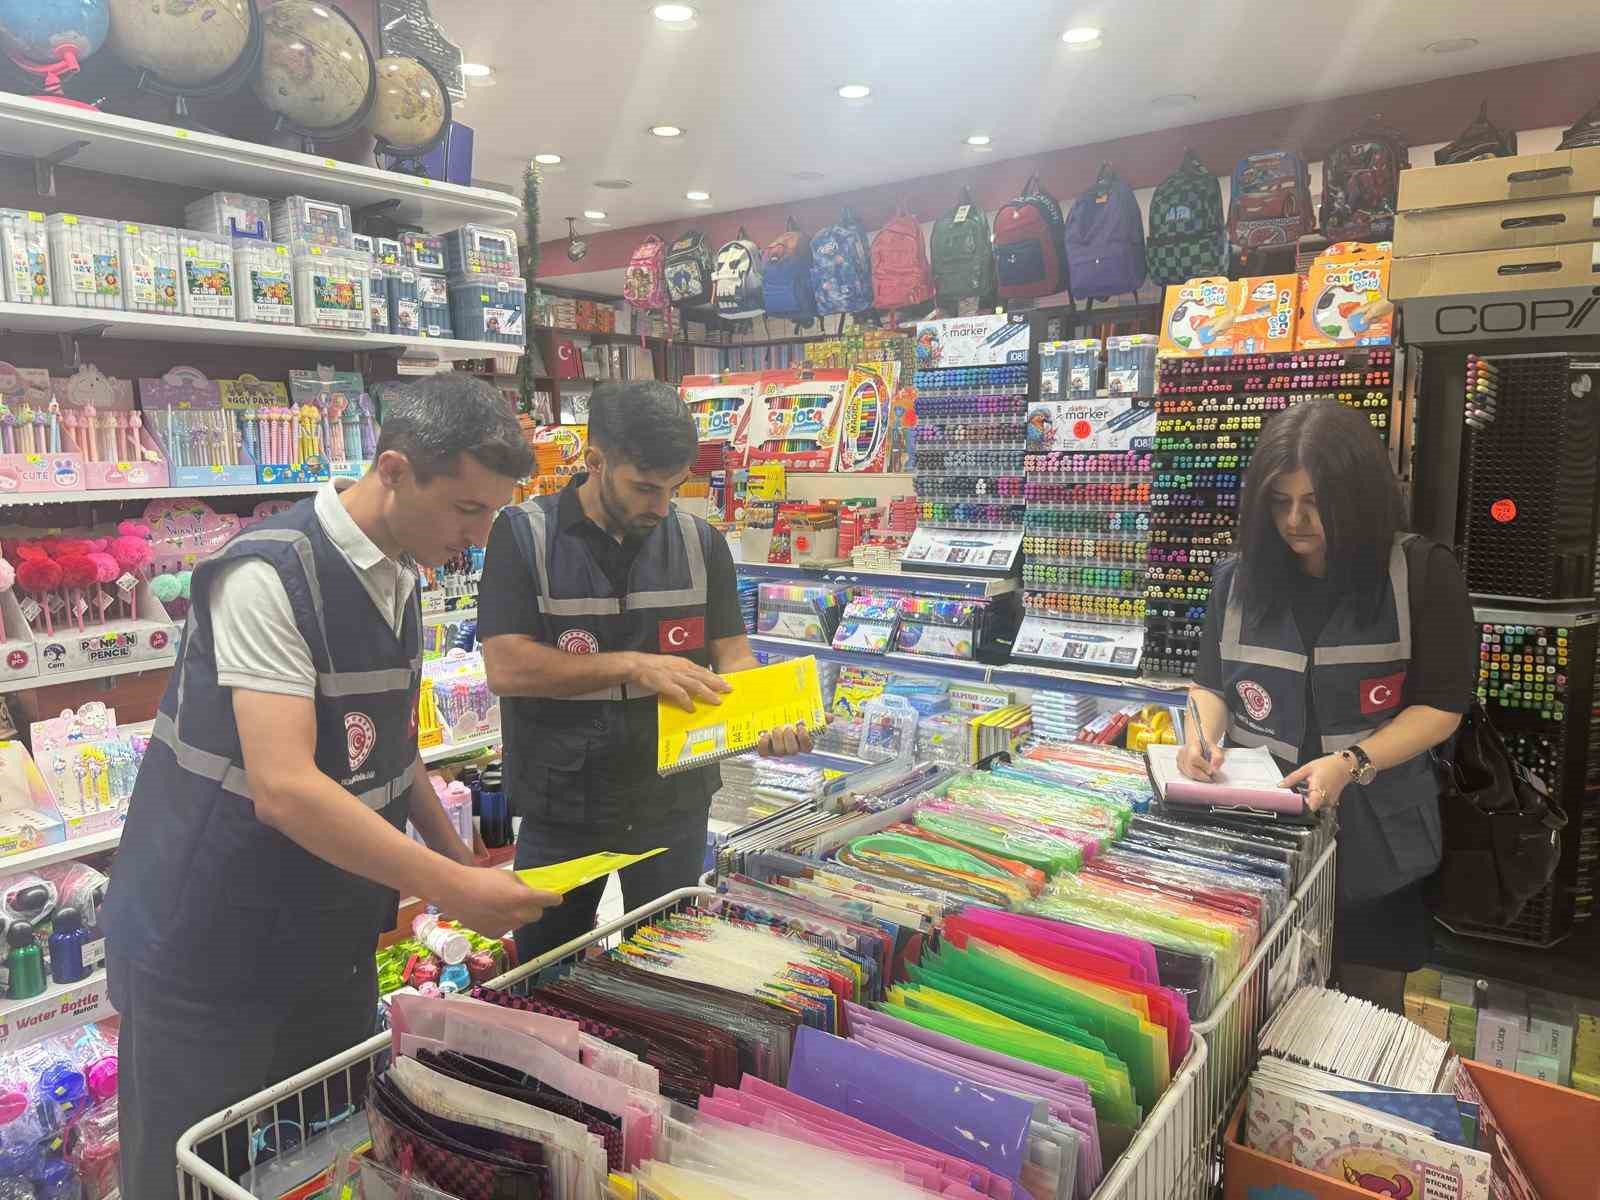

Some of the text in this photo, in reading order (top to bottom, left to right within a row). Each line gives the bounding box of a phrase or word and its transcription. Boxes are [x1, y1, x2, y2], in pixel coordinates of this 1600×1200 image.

[950, 326, 988, 338] marker
[1064, 407, 1109, 420] marker
[22, 471, 49, 480] CUTE
[90, 648, 129, 661] PENCIL
[16, 992, 99, 1031] Water Bottle
[1425, 1168, 1457, 1184] BOYAMA
[1425, 1177, 1458, 1192] STICKER
